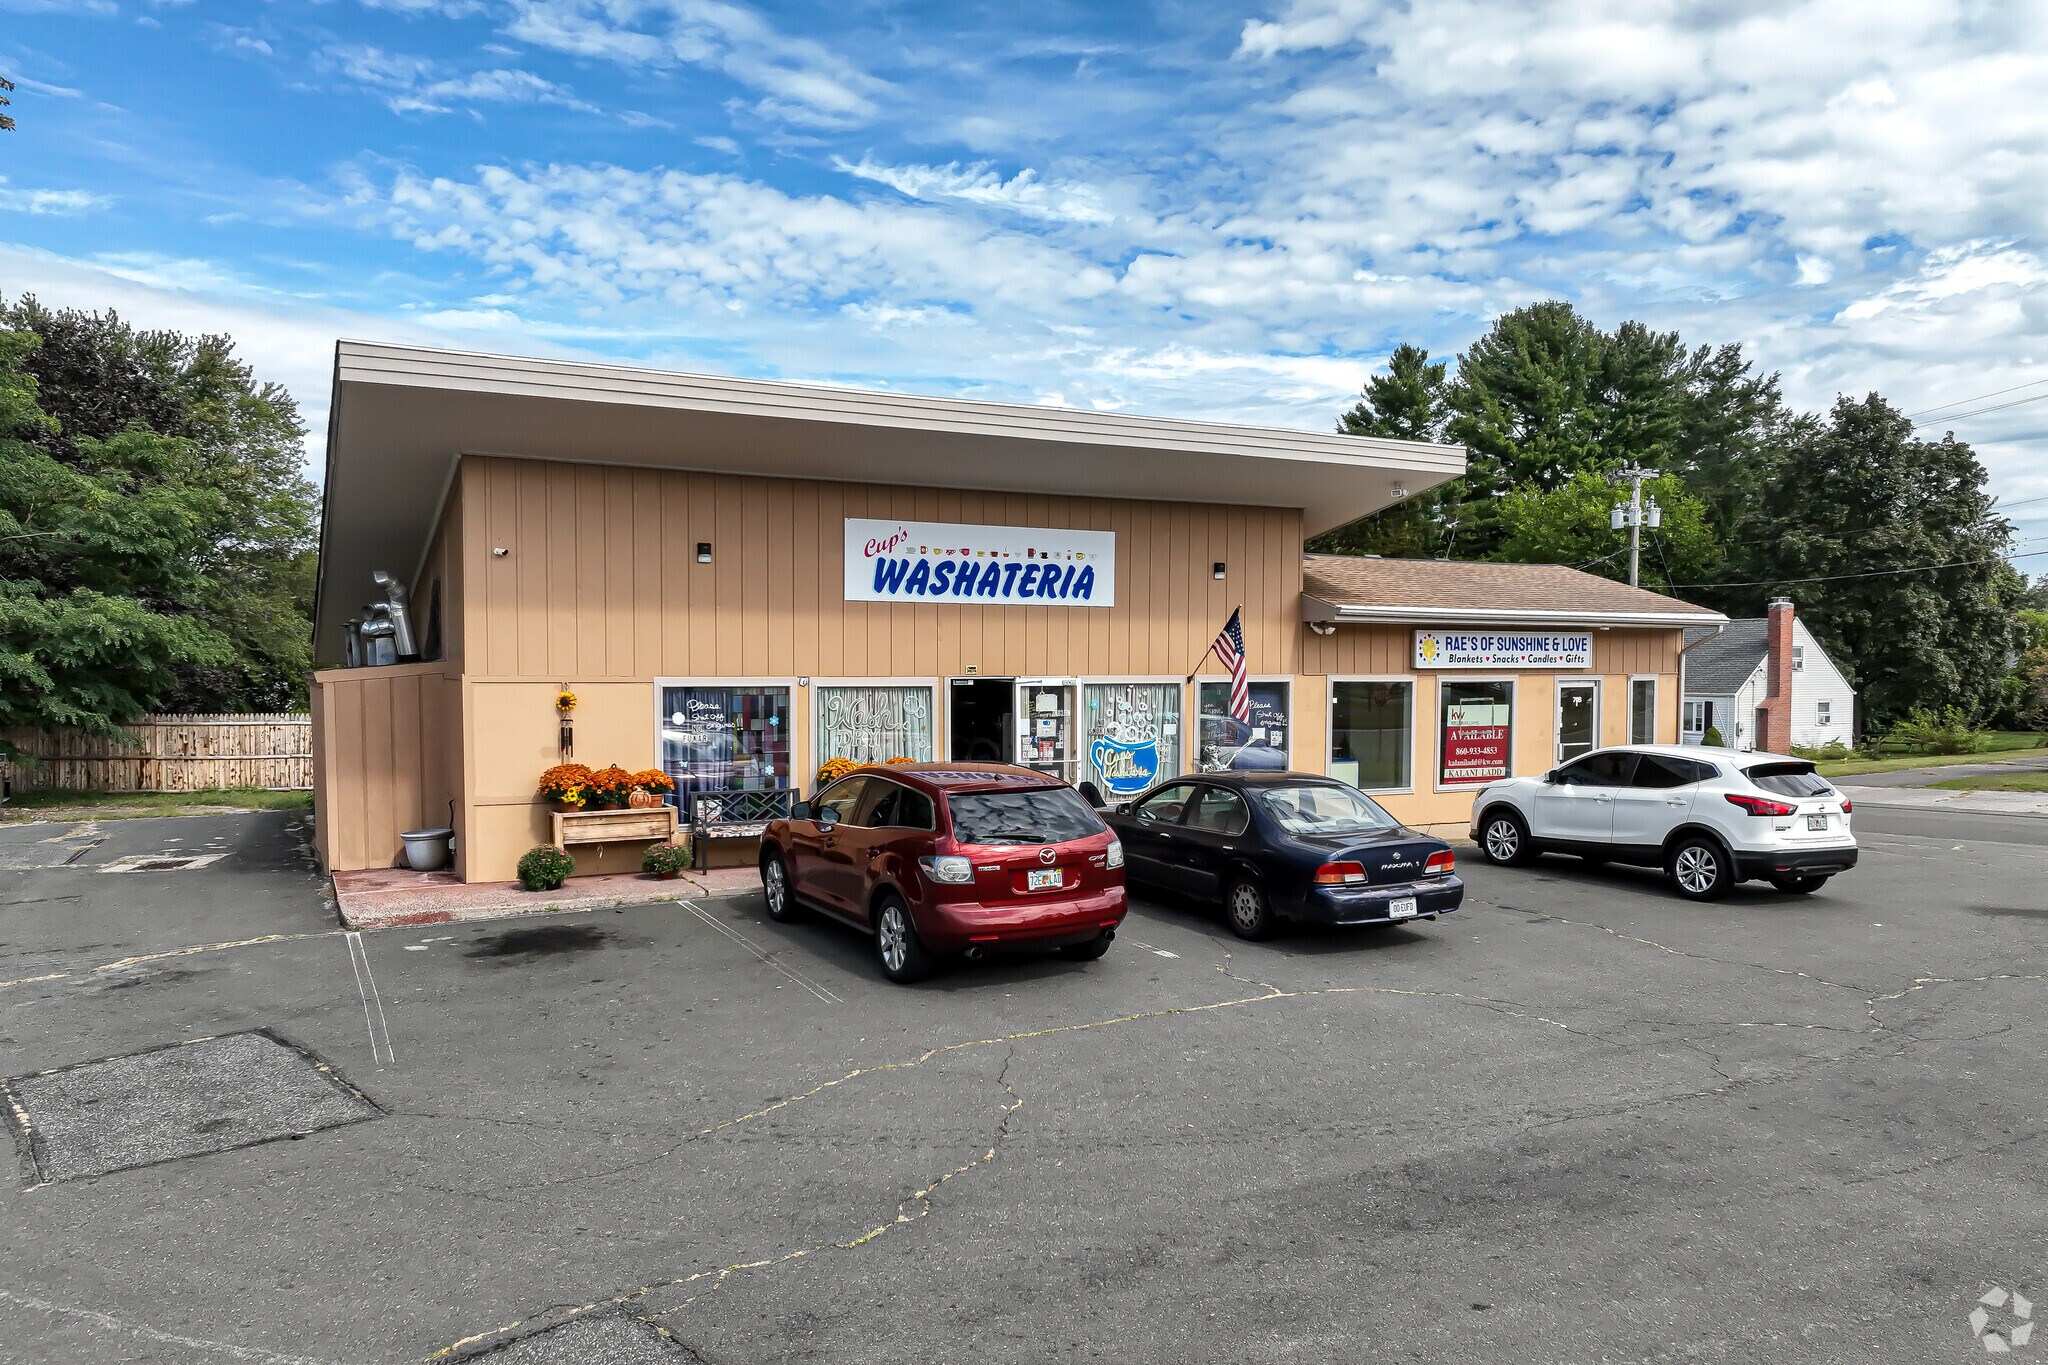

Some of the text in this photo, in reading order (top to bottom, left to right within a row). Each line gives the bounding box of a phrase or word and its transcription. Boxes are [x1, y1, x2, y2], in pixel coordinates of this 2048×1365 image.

[864, 526, 908, 558] Cup's
[872, 557, 1095, 600] WASHATERIA
[1445, 636, 1587, 652] RAE'S OF SUNSHINE & LOVE
[1449, 654, 1585, 664] Blankets Snacks Candles Gifts
[687, 699, 721, 712] Please
[1248, 699, 1272, 710] Please
[692, 713, 709, 721] Shut
[1256, 710, 1272, 719] Shut
[1451, 708, 1465, 720] kw
[838, 729, 881, 746] DRY
[1450, 730, 1504, 741] AVAILABLE
[1455, 746, 1498, 756] 860-933-4853
[1448, 768, 1503, 778] KALANI LADD
